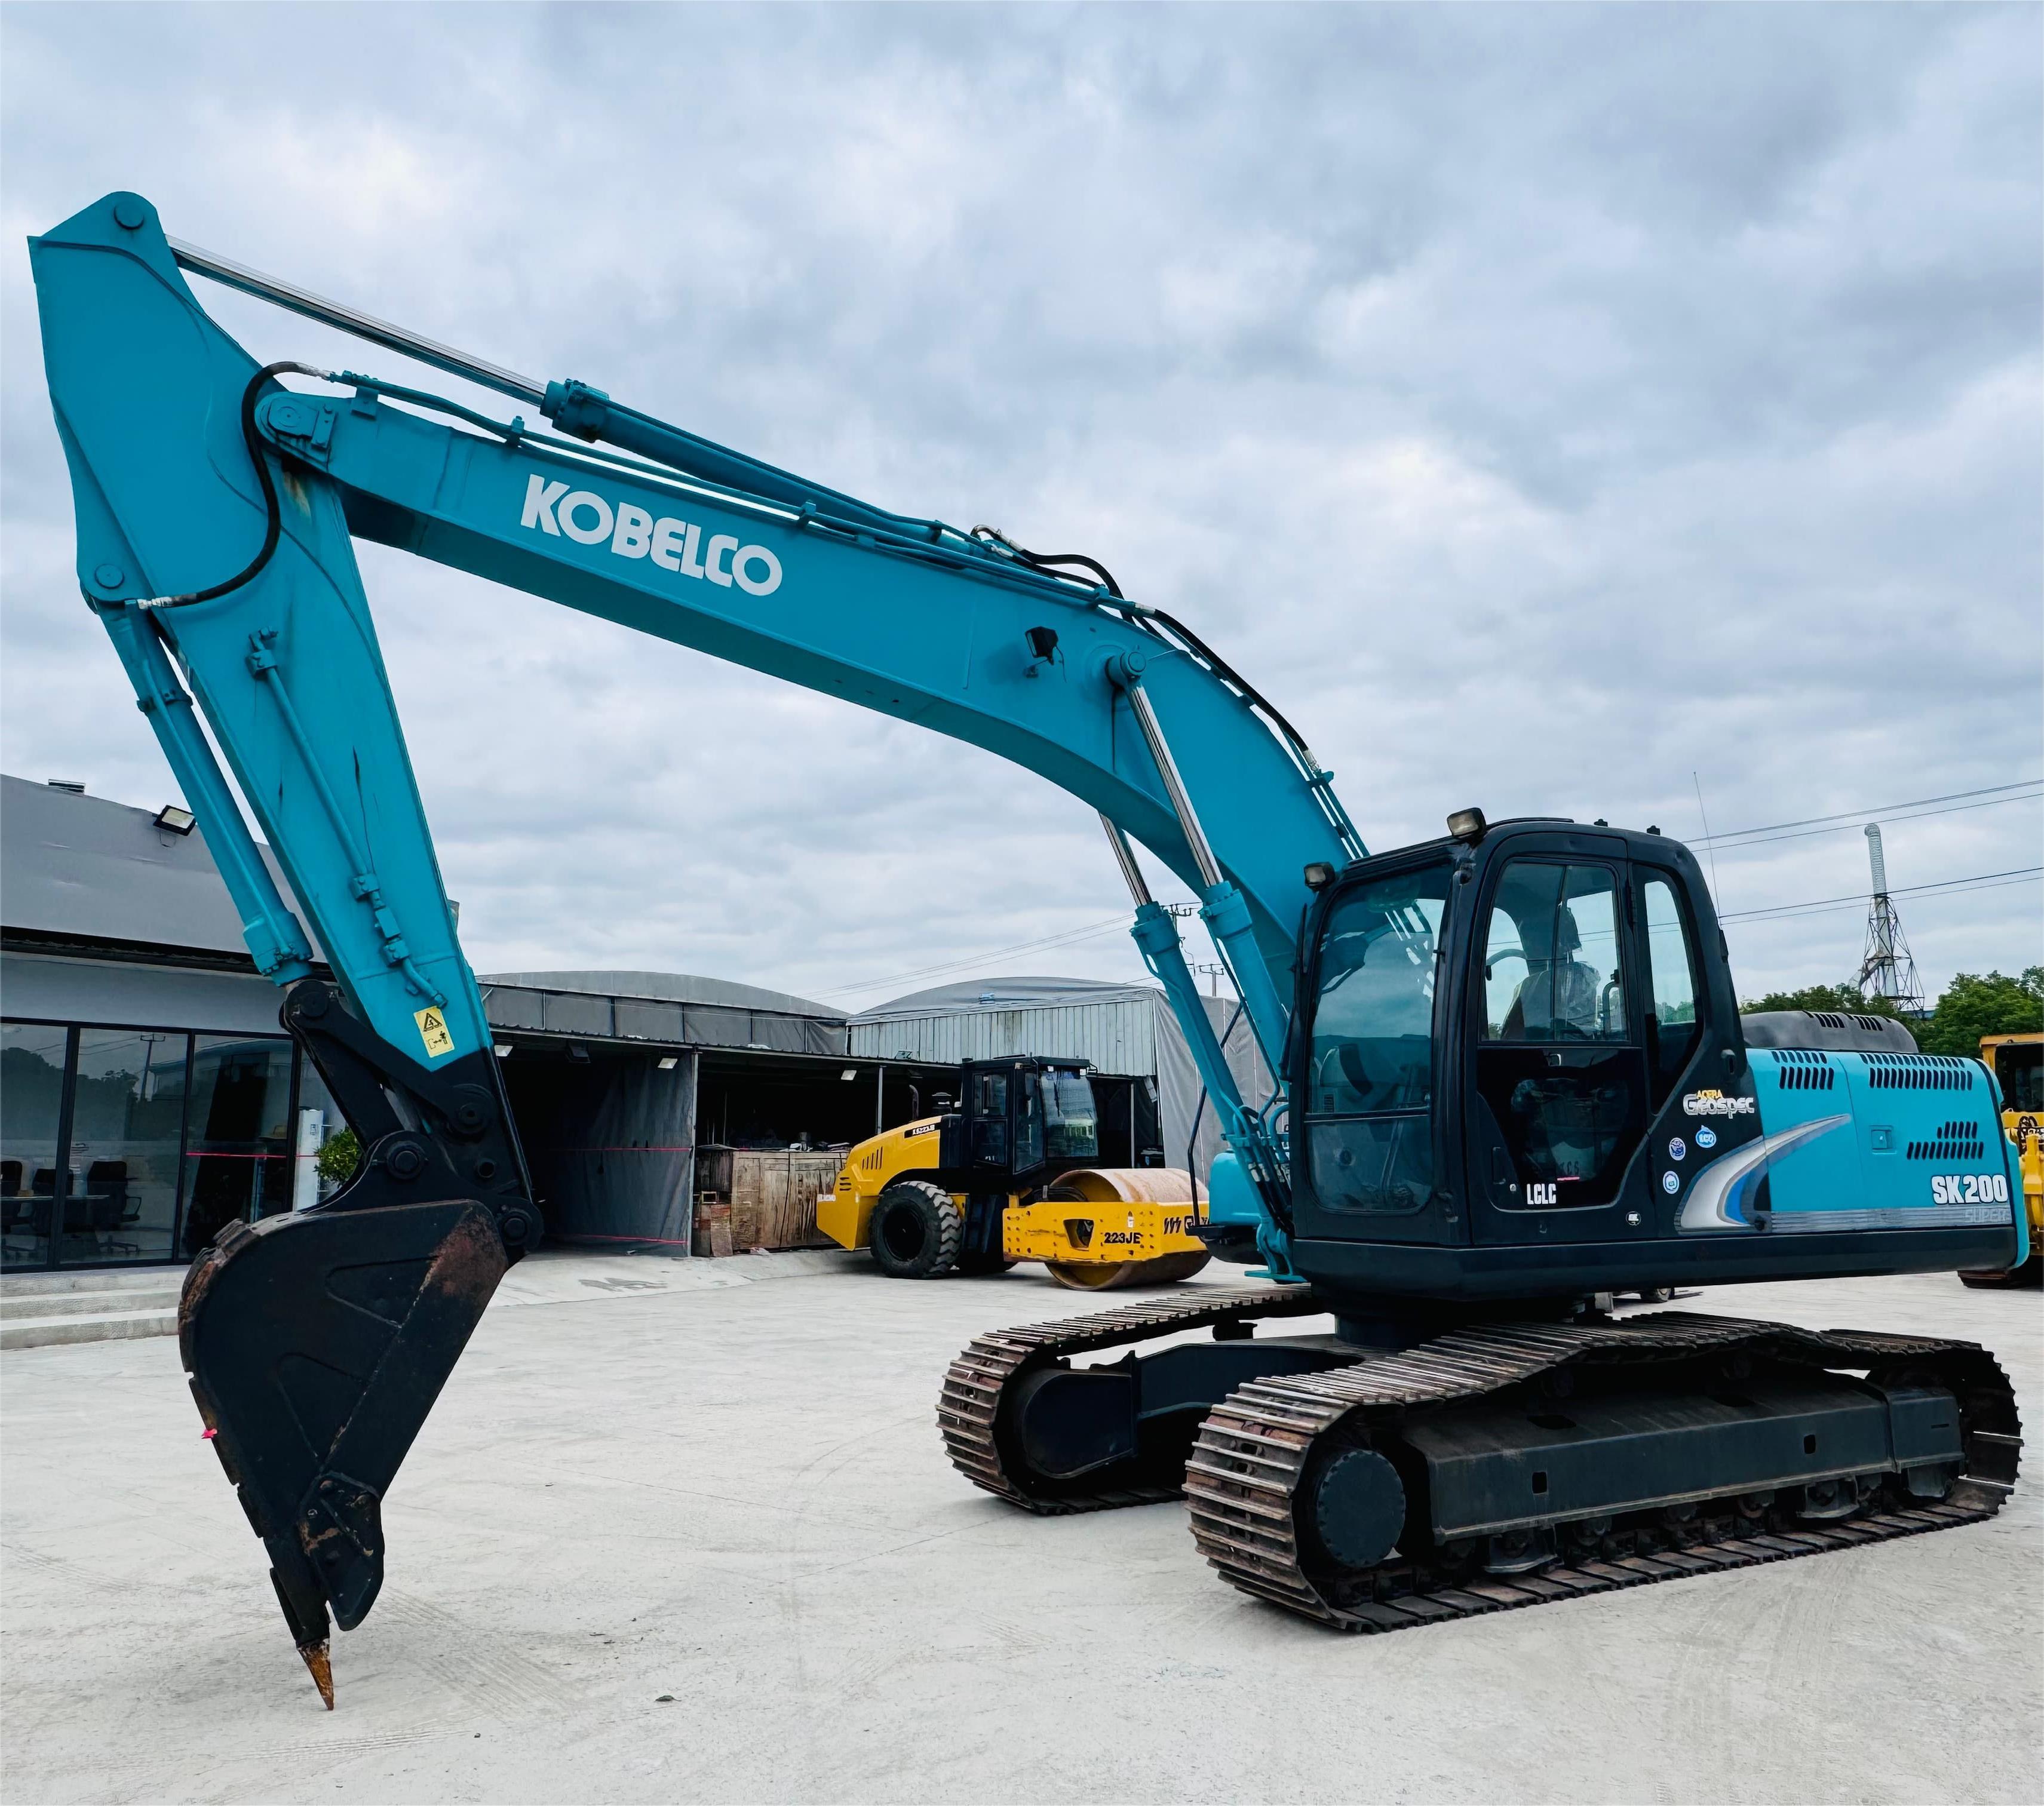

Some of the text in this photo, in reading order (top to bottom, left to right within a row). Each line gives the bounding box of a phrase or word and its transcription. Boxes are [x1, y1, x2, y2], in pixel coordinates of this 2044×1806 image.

[521, 474, 782, 596] KOBELCO
[1683, 1094, 1755, 1119] Geospec
[1527, 1183, 1557, 1205] LCLC
[1931, 1174, 2008, 1205] SK200
[1104, 1232, 1142, 1244] 223JE
